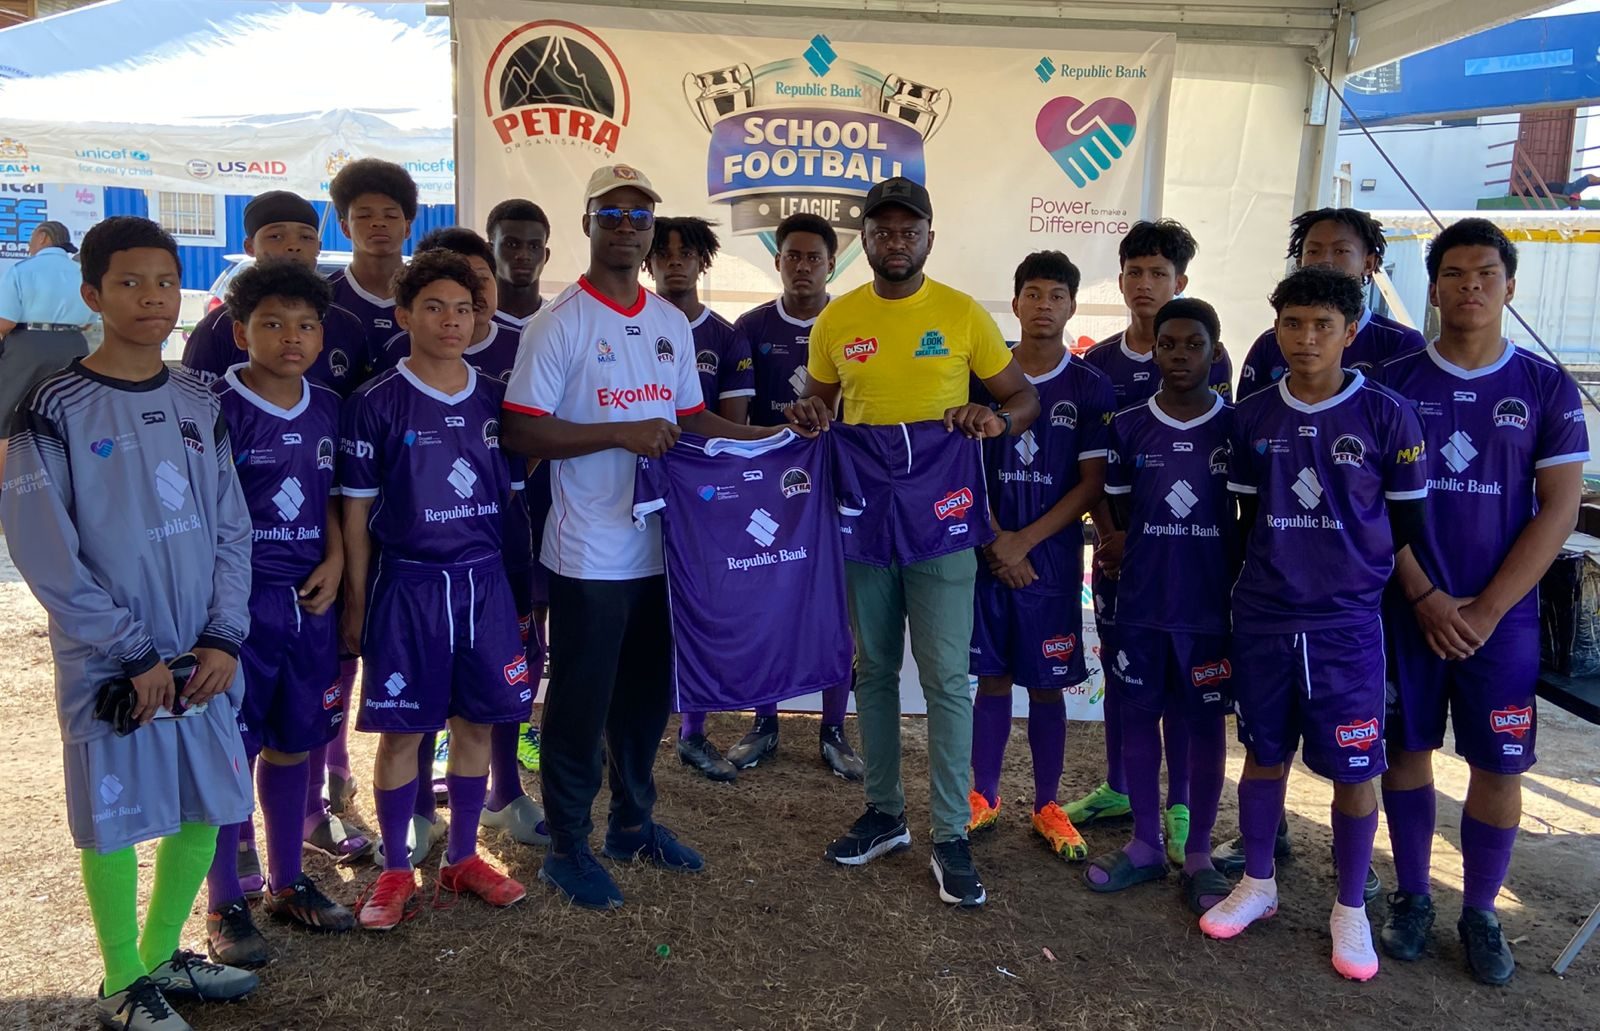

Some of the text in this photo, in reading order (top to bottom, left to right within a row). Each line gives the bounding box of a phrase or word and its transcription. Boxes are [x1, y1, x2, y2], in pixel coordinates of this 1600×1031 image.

[1499, 51, 1571, 68] TADANO
[1061, 64, 1147, 80] Republic Bank
[775, 81, 862, 98] Republic Bank
[492, 107, 621, 154] PETRA
[743, 117, 887, 150] SCHOOL
[75, 147, 127, 159] unicef
[505, 138, 611, 159] ORGANISATION
[79, 163, 153, 176] for every child
[217, 161, 287, 175] USAID
[780, 197, 841, 222] LEAGUE
[1030, 197, 1091, 215] Power
[1091, 208, 1099, 216] to
[1100, 208, 1121, 216] make
[1030, 215, 1129, 234] Difference
[845, 340, 875, 357] BUSTA
[922, 337, 943, 346] LOOK
[1495, 414, 1528, 428] PETRA
[1333, 453, 1363, 466] PETRA
[783, 483, 811, 496] PETRA
[1425, 477, 1502, 495] public Bank
[938, 492, 971, 515] BUSTA
[424, 504, 475, 523] Republic
[1267, 514, 1319, 530] Republic
[252, 525, 321, 542] epublic Bank
[1143, 522, 1220, 537] Republic Bank
[727, 546, 807, 571] Republic Bank
[1045, 638, 1074, 653] BUSTA
[1194, 663, 1228, 681] BUSTA
[1125, 676, 1144, 686] Bank
[365, 698, 420, 710] Republic Bank
[1494, 711, 1531, 727] BUSTA
[1340, 723, 1376, 741] BUSTA
[119, 804, 142, 817] Bank
